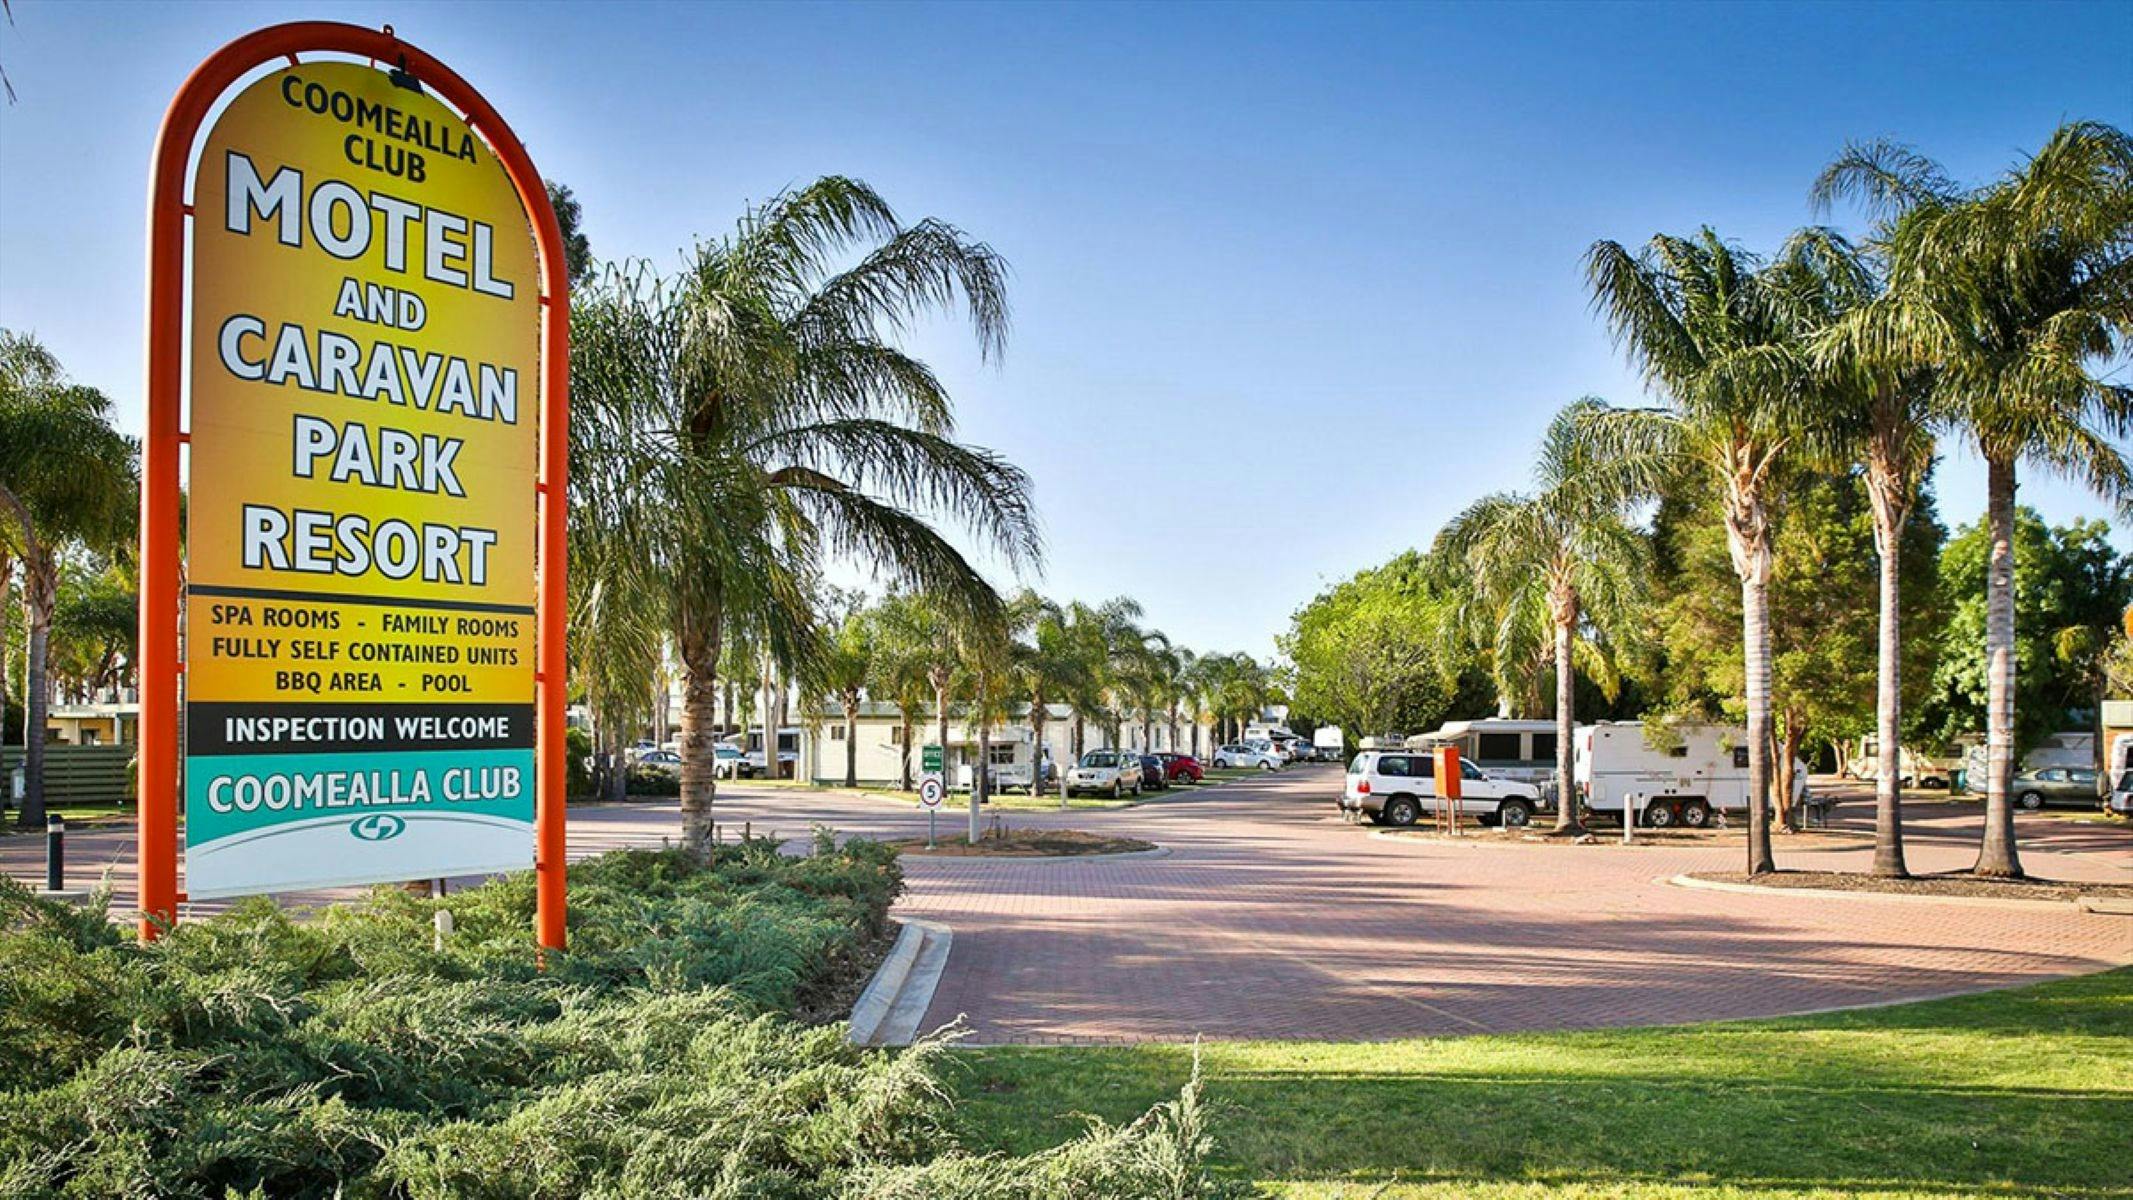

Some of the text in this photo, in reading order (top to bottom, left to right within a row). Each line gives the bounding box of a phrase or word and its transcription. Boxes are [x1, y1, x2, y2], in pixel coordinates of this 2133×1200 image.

[281, 75, 477, 164] COOMEALLA
[344, 134, 426, 183] CLUB
[225, 150, 514, 300] MOTEL
[334, 278, 426, 331] AND
[218, 314, 517, 424] CARAVAN
[293, 414, 466, 498] PARK
[241, 503, 497, 586] RESORT
[211, 605, 253, 626] SPA
[263, 608, 340, 630] ROOMS
[382, 614, 449, 635] FAMILY
[457, 618, 519, 638] ROOMS
[212, 637, 518, 666] FULLY SELF CONTAINED UNITS
[276, 672, 322, 694] BBQ
[329, 672, 382, 692] AREA
[422, 674, 472, 692] POOL
[226, 717, 509, 742] INSPECTION WELCOME
[208, 766, 521, 813] COOMEALLA CLUB
[927, 785, 935, 798] 5
